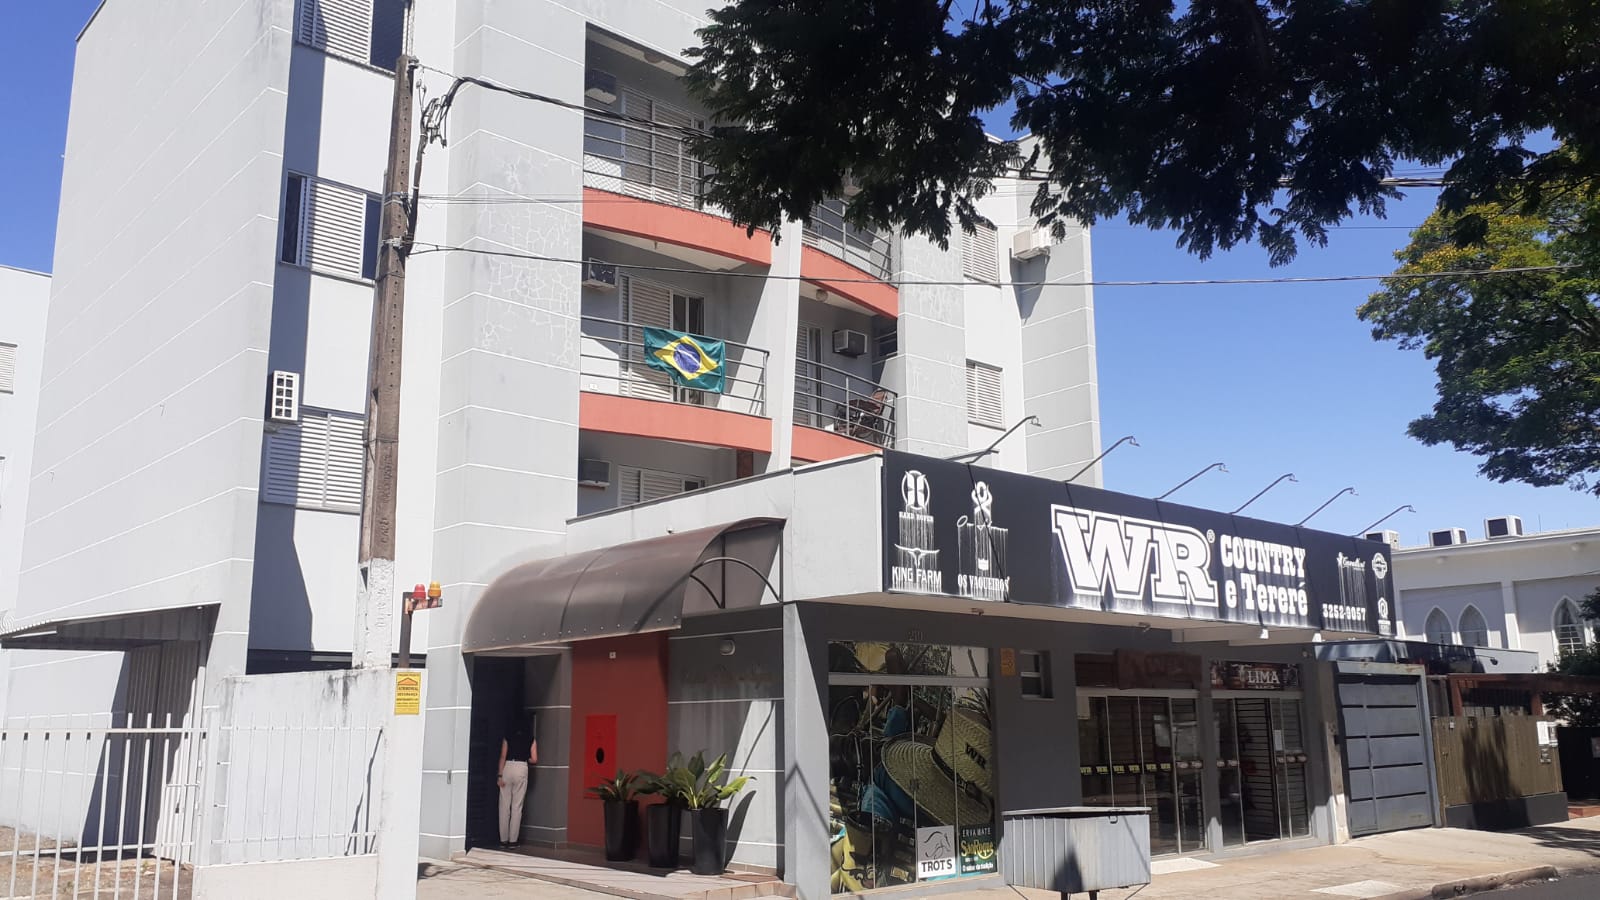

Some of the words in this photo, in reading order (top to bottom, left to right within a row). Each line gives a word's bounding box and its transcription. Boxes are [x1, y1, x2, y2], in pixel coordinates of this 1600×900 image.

[1050, 503, 1218, 607] WR
[1220, 534, 1306, 578] COUNTRY
[891, 566, 913, 583] KING
[916, 569, 942, 586] FARM
[957, 573, 968, 586] OS
[968, 574, 1010, 592] VAQUEIROS
[1225, 579, 1237, 608] e
[1240, 572, 1309, 616] Tereré
[1247, 670, 1281, 684] LIMA
[965, 742, 986, 768] WR
[962, 828, 976, 837] ERVA
[977, 827, 991, 836] MATE
[921, 859, 953, 873] TROTS
